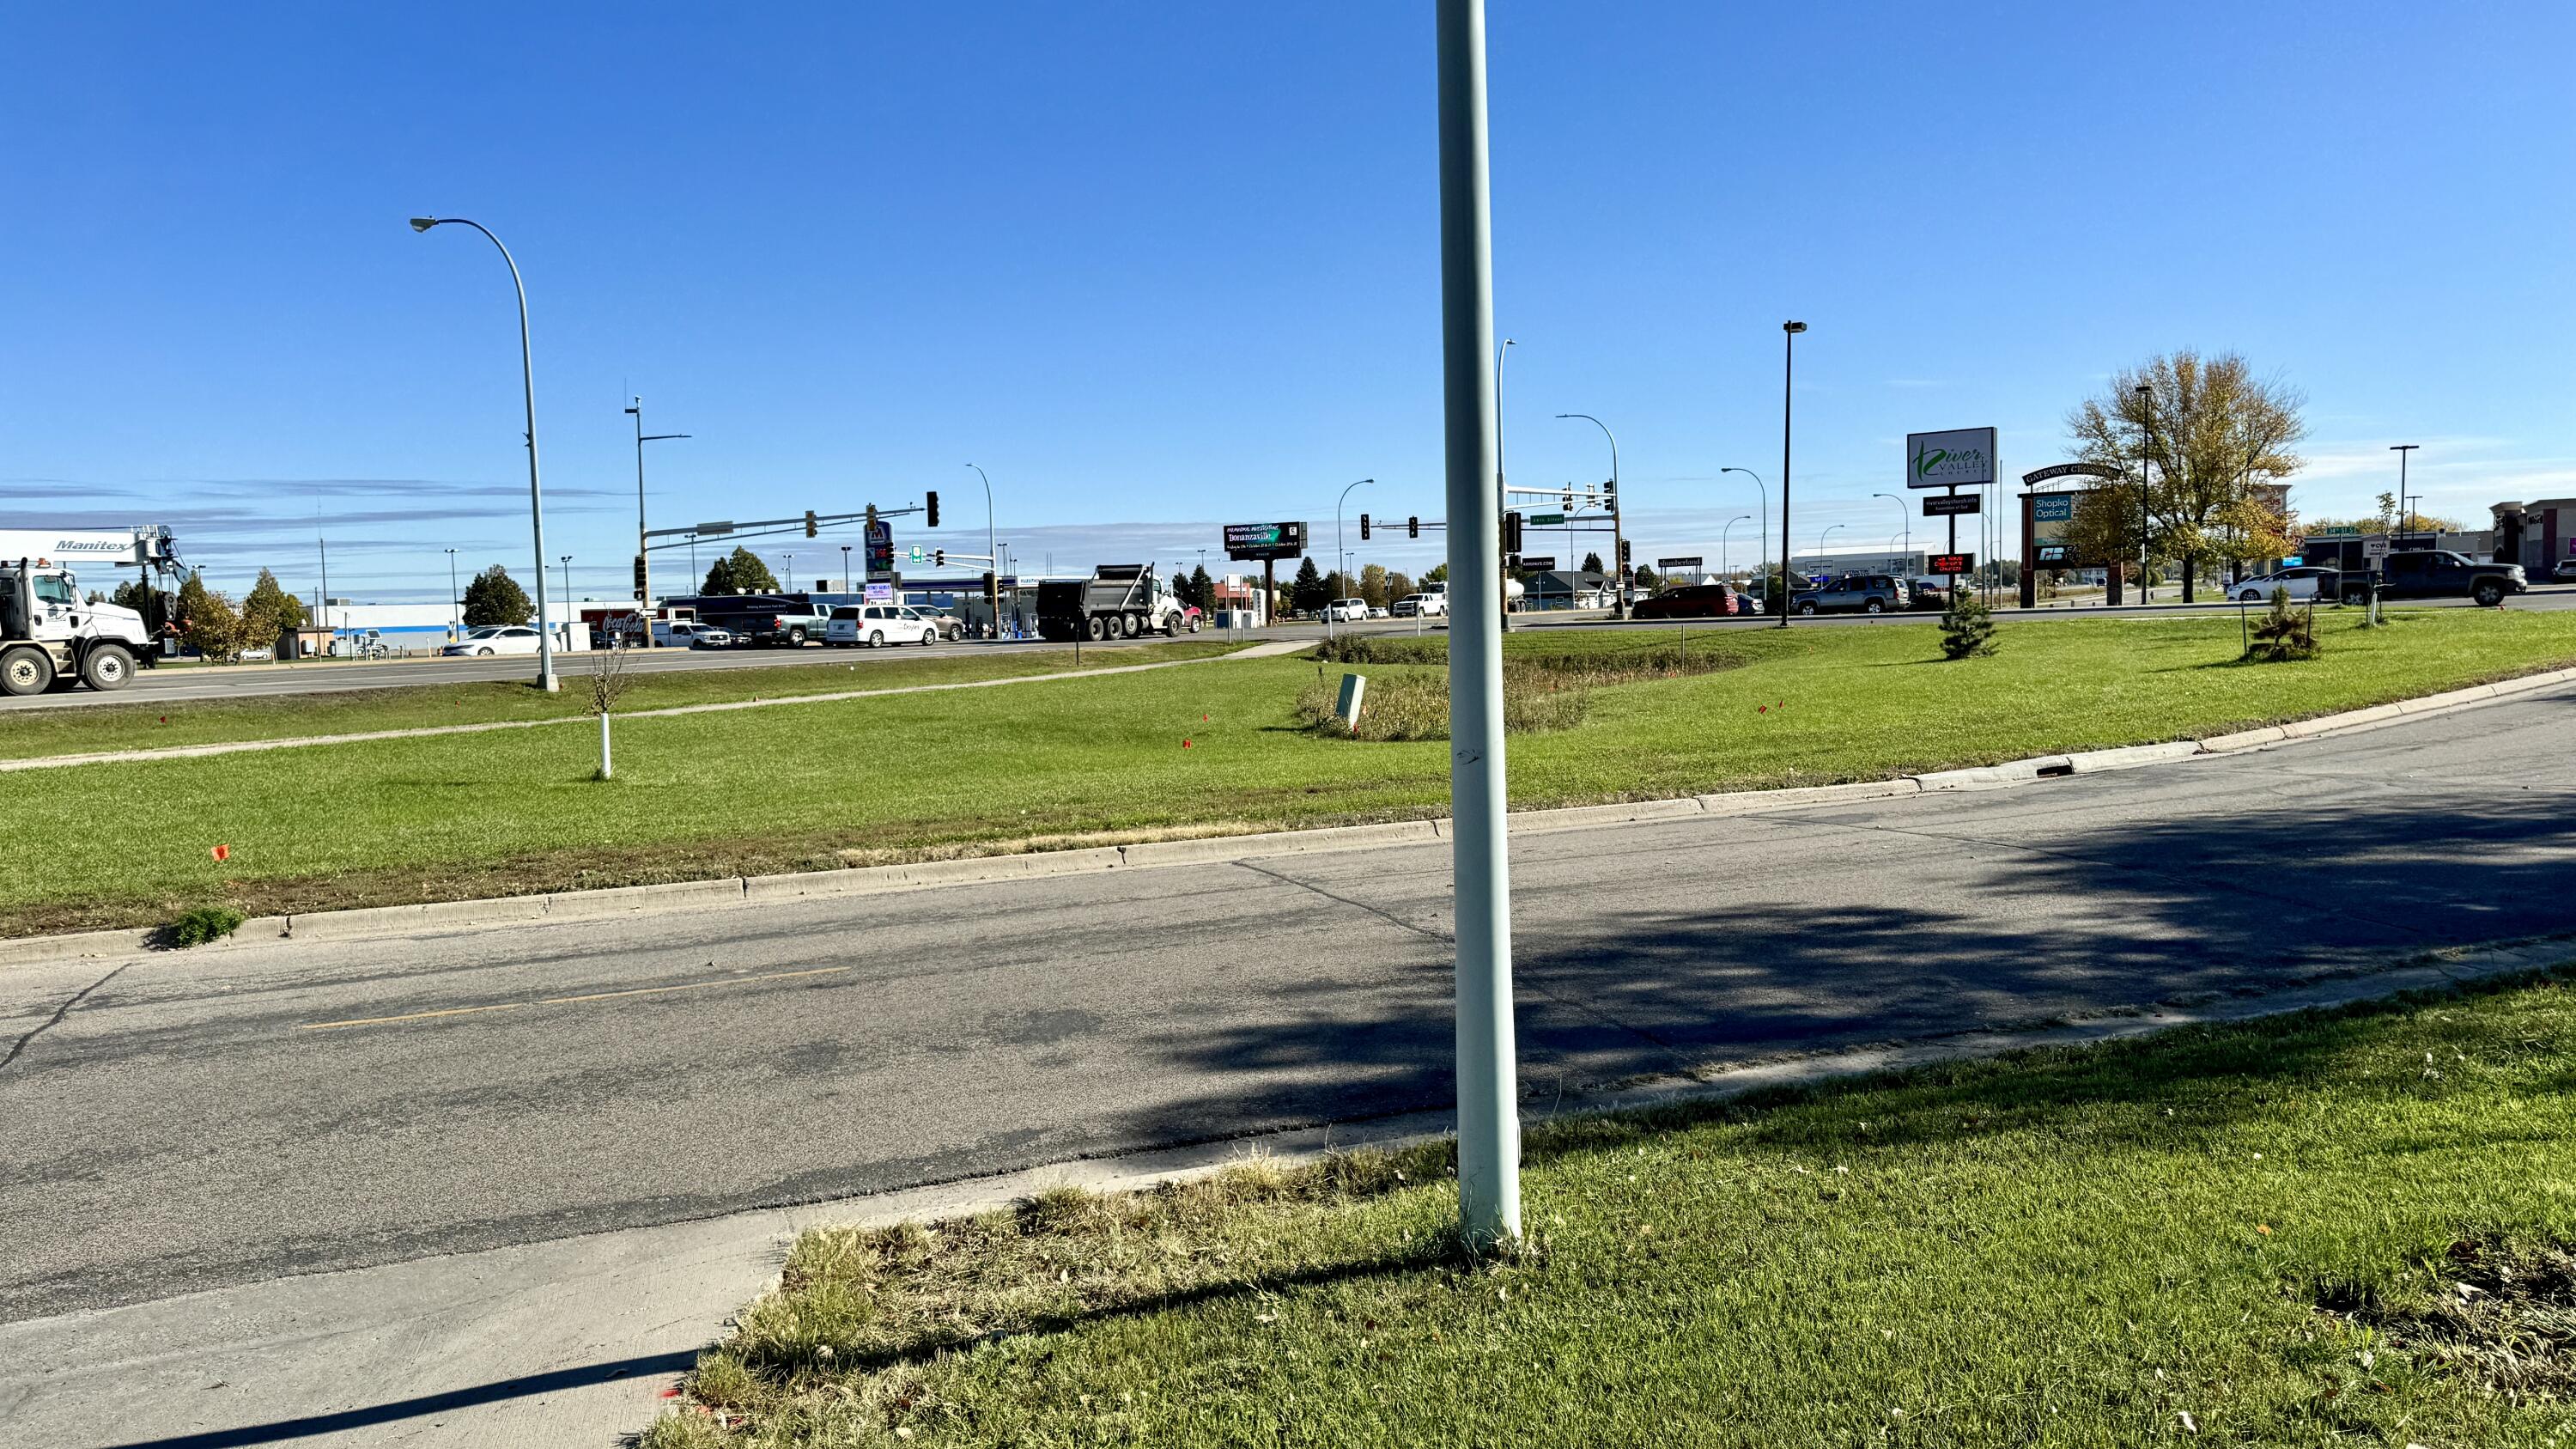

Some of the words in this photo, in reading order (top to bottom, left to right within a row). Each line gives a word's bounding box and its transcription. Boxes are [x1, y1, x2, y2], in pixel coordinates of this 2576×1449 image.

[2026, 466, 2068, 483] GATEWAY
[2036, 499, 2069, 508] Shopko
[2036, 508, 2067, 518] Optical
[1229, 532, 1271, 542] Bonanzaville
[56, 540, 128, 551] Manitex
